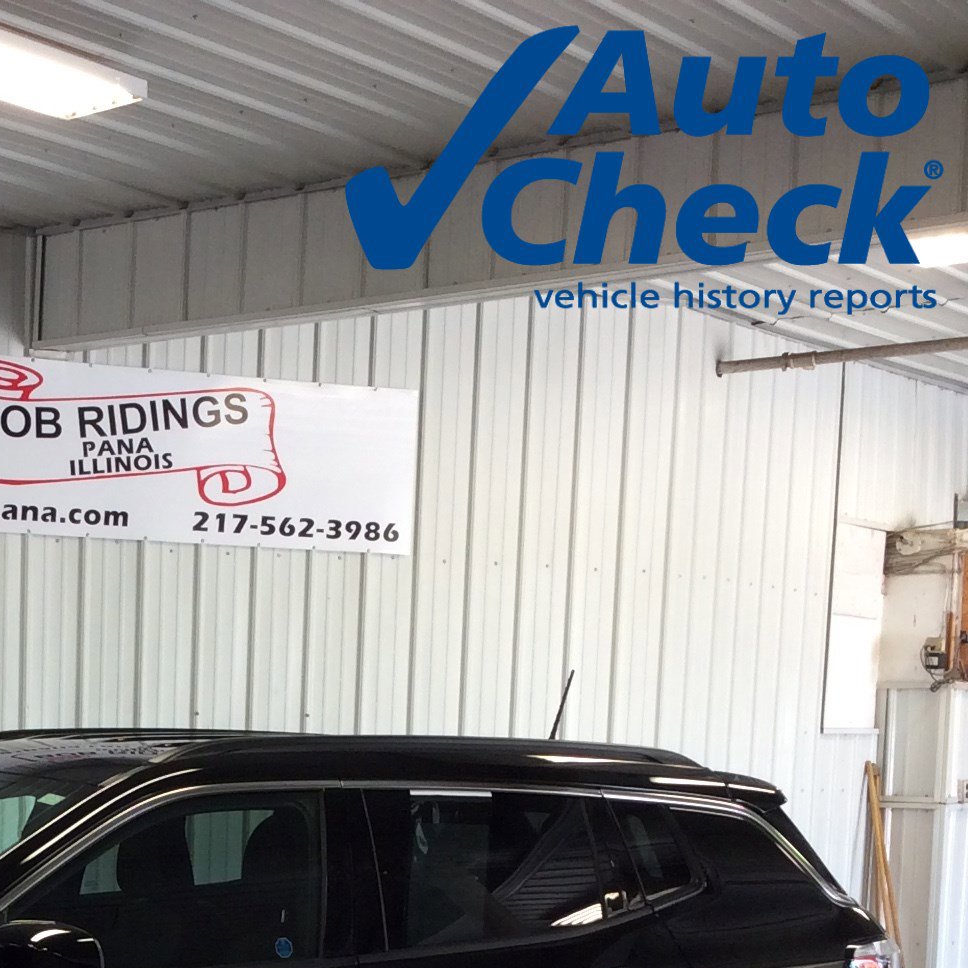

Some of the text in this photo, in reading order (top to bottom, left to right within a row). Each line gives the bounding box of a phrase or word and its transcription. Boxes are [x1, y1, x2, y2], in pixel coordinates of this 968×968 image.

[77, 393, 249, 439] RIDINGS
[82, 437, 154, 458] PANA
[69, 452, 173, 476] ILLINOIS
[192, 511, 399, 542] 217-562-3986
